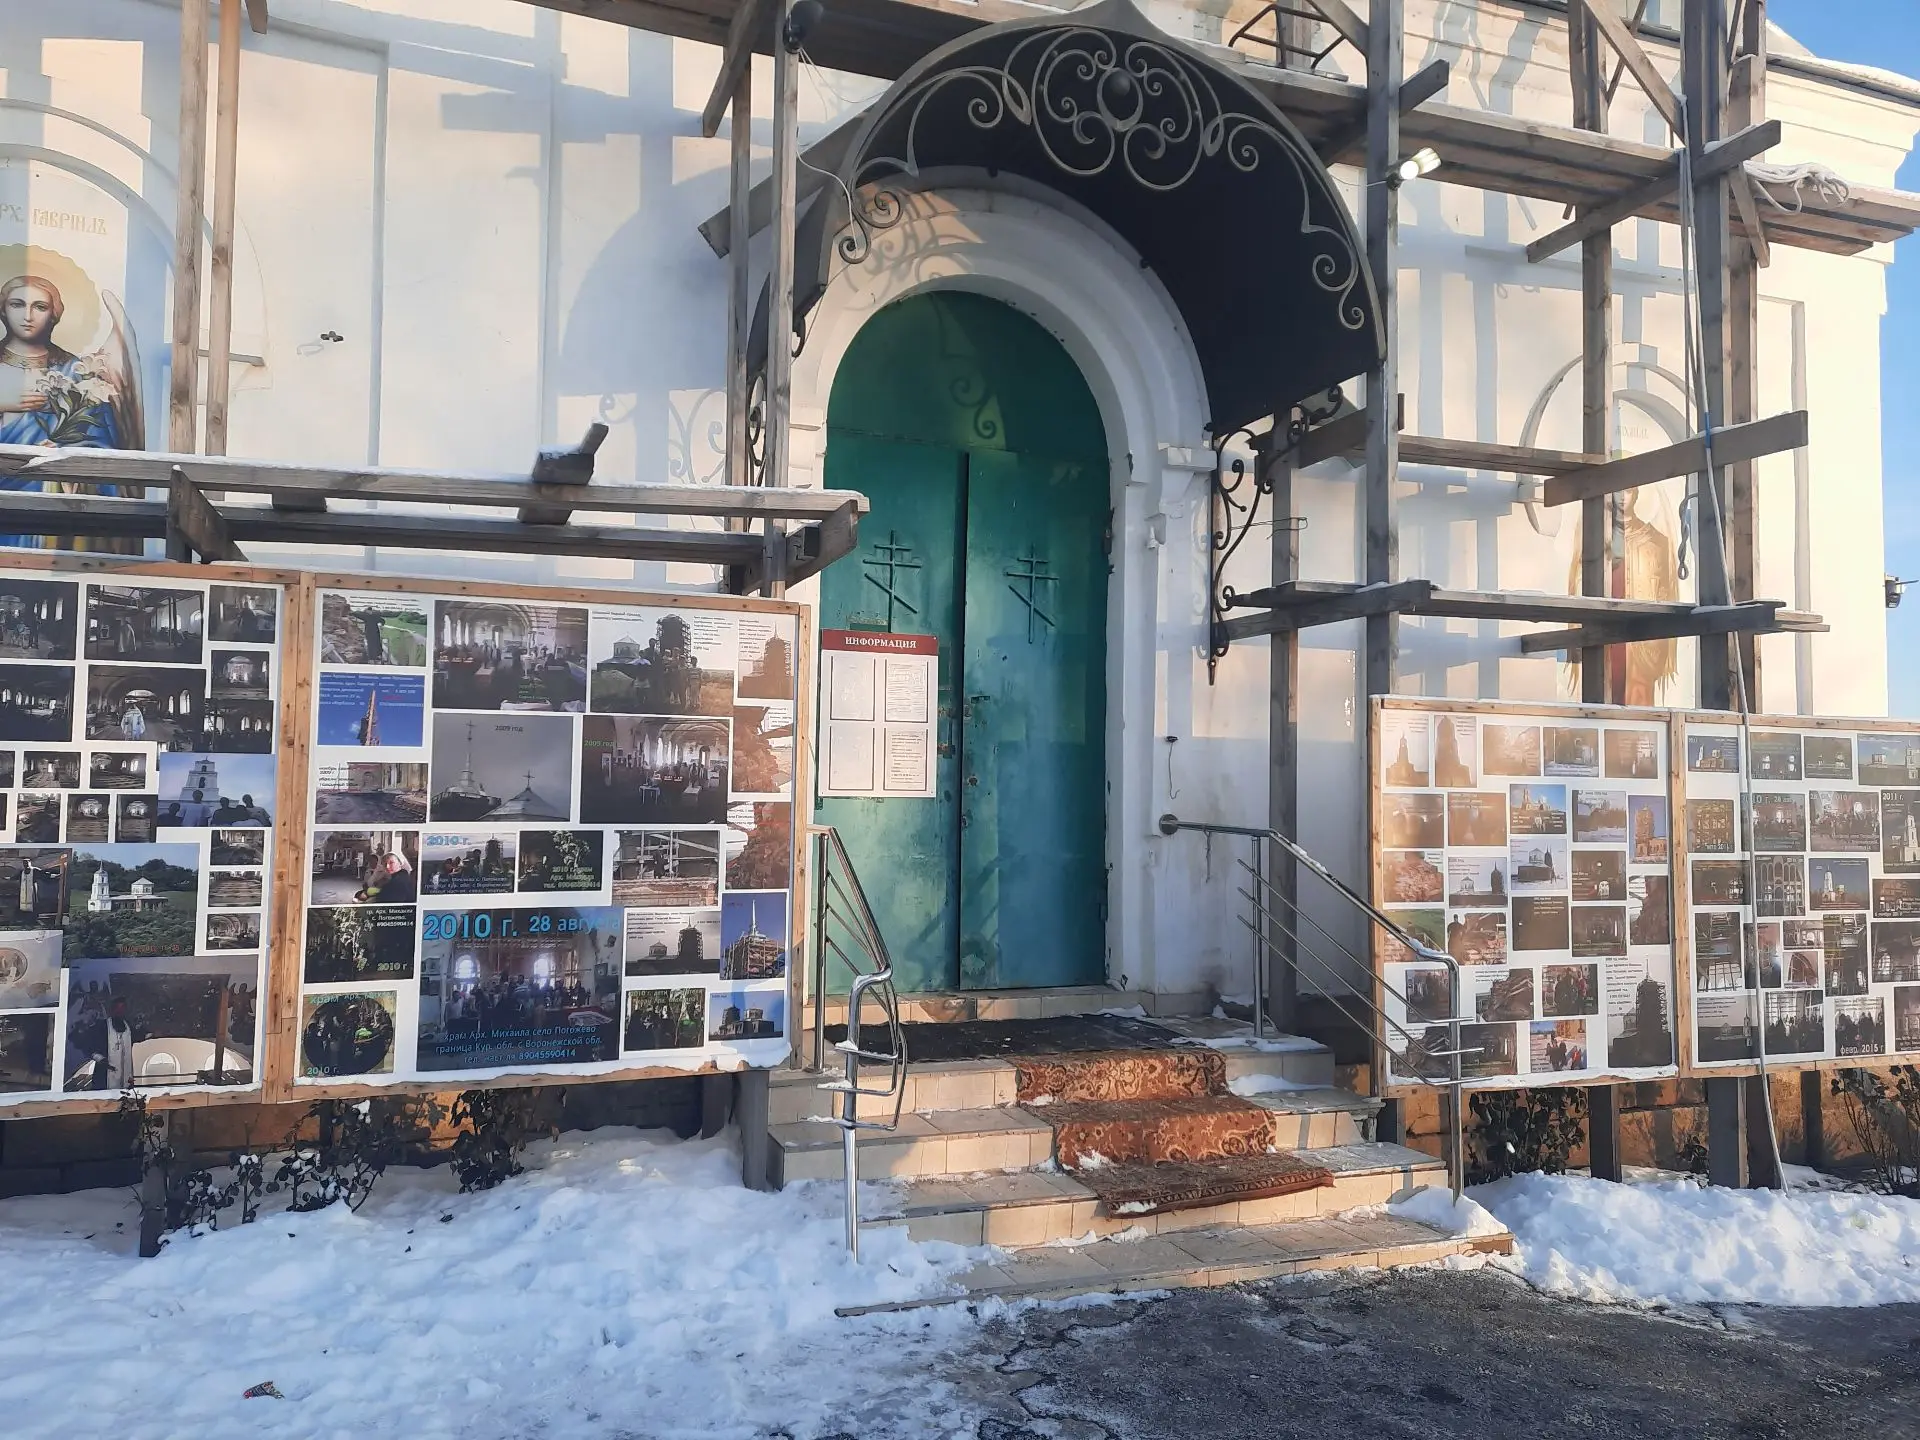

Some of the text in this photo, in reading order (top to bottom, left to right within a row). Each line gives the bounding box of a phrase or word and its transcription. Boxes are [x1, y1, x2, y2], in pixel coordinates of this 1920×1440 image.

[845, 636, 917, 649] ИНФОРМАЦИЯ
[427, 835, 459, 846] 2010
[422, 914, 492, 940] 2010
[501, 918, 519, 937] г.
[529, 915, 552, 932] 28
[377, 962, 401, 971] 2010
[445, 1025, 596, 1043] храм Арх. Михаила село Погожево
[435, 1044, 472, 1055] граница
[475, 1043, 493, 1053] Кур.
[496, 1040, 514, 1050] обл.
[525, 1036, 583, 1049] Воронежской
[585, 1035, 603, 1045] обл.
[307, 1066, 330, 1075] 2010
